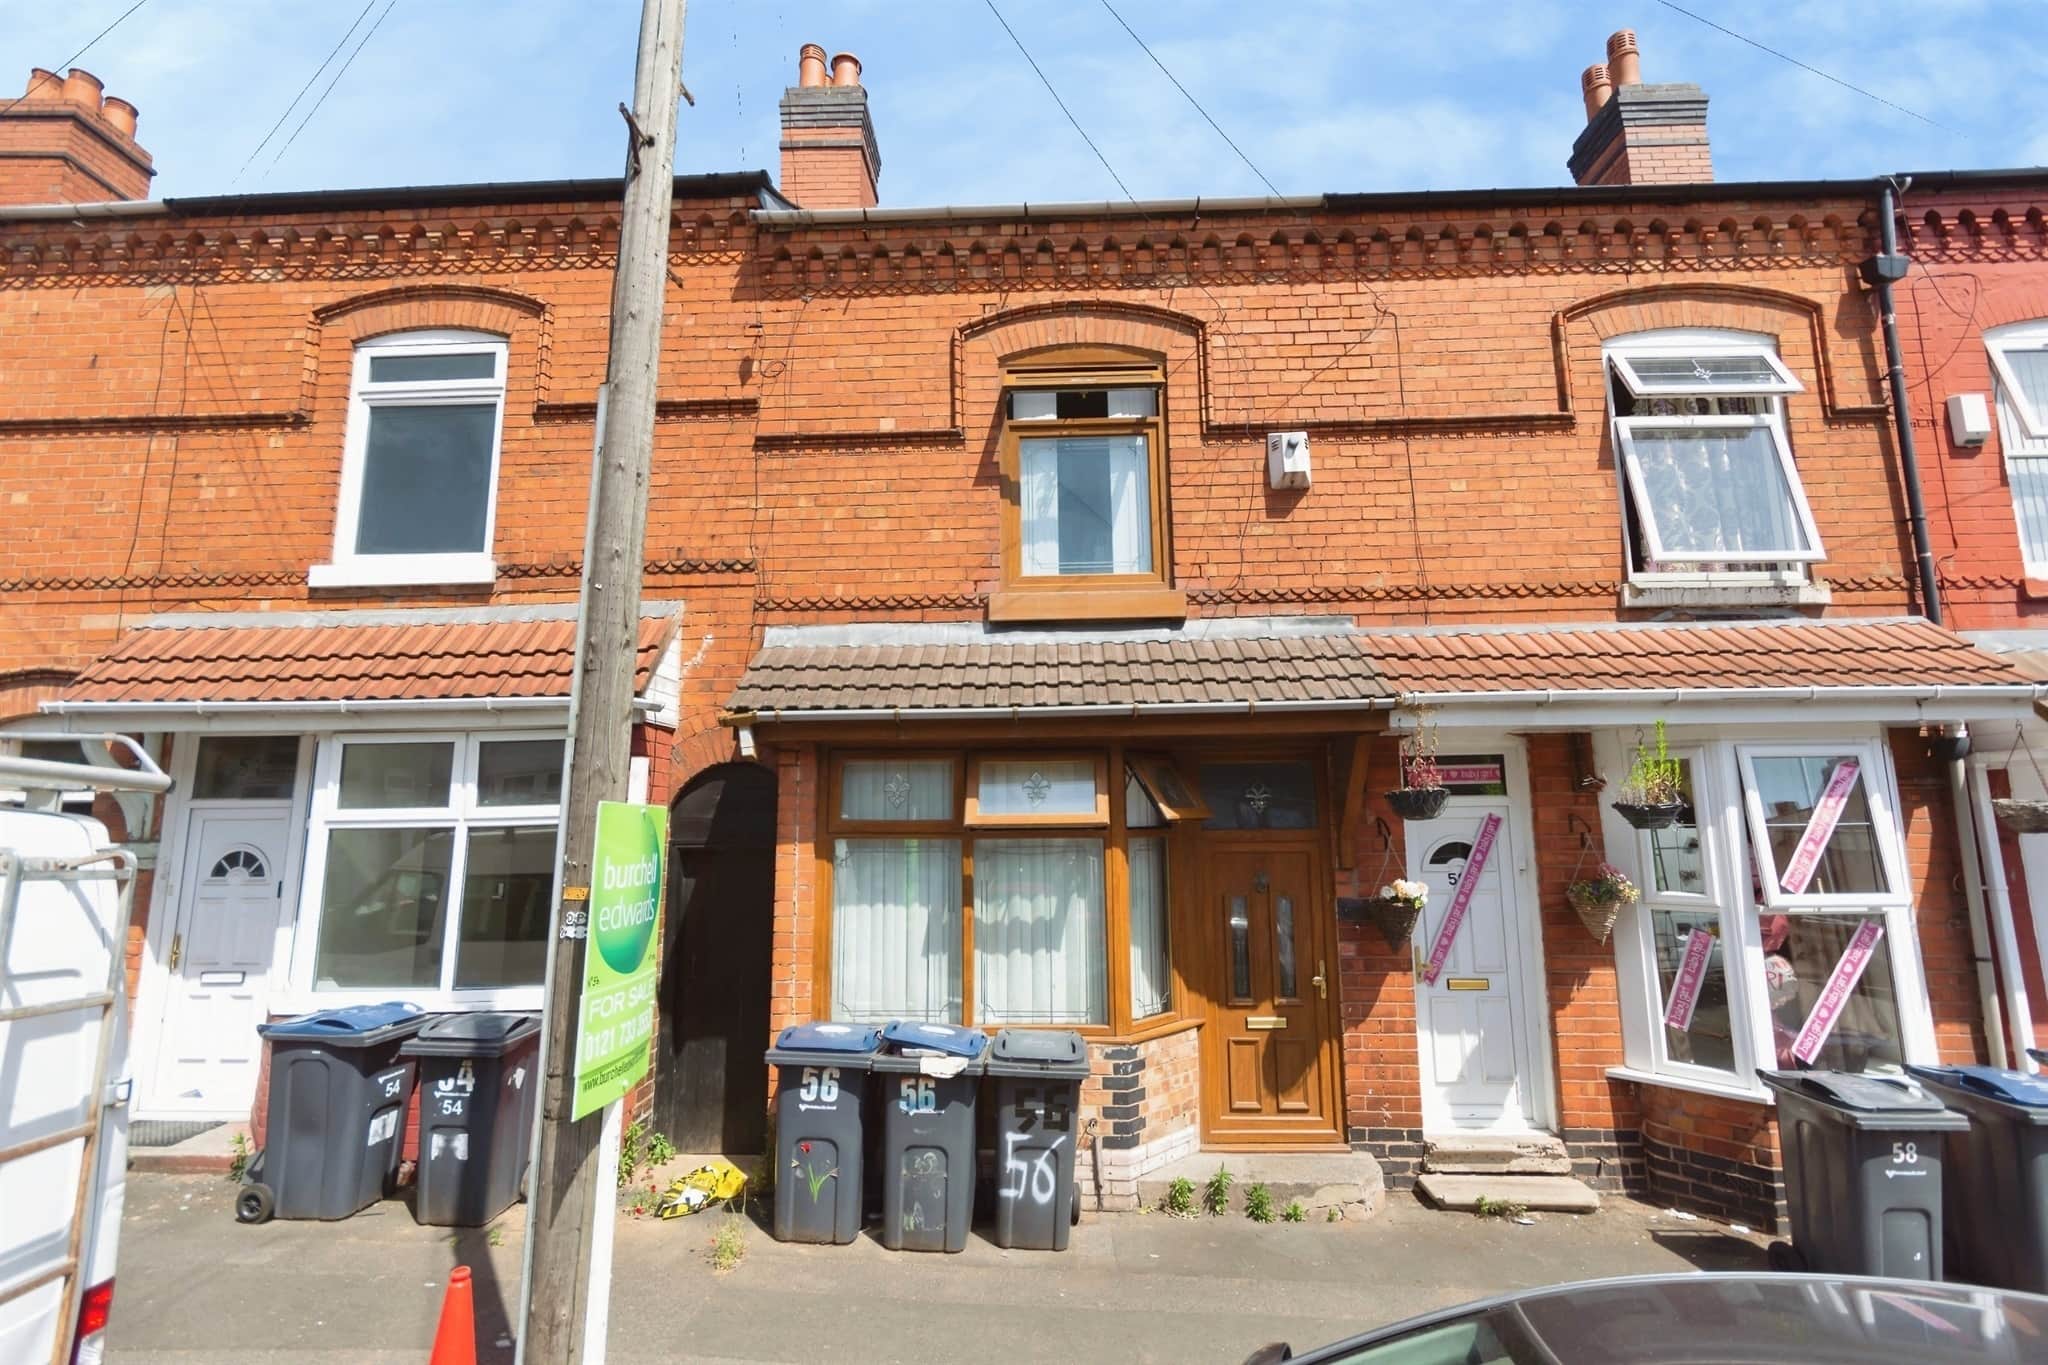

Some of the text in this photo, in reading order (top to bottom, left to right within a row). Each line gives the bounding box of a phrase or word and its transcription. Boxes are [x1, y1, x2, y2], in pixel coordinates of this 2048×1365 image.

[1486, 821, 1499, 835] girl
[1479, 833, 1495, 852] baby
[603, 852, 658, 890] burchell
[1447, 872, 1461, 886] 5
[1469, 862, 1482, 876] girl
[1463, 875, 1477, 894] baby
[599, 889, 656, 931] edwards
[1452, 904, 1465, 918] girl
[1445, 916, 1461, 937] baby
[1686, 951, 1704, 973] baby
[588, 991, 625, 1024] FOR
[628, 973, 656, 1008] SALE
[1678, 985, 1693, 1001] girl
[1799, 1031, 1819, 1055] baby
[1809, 1018, 1826, 1034] girl
[1824, 986, 1844, 1009] baby
[1834, 973, 1851, 990] girl
[1849, 941, 1869, 964] baby
[1671, 1000, 1690, 1021] baby
[584, 1026, 615, 1062] 0121
[385, 1080, 401, 1097] 54
[800, 1067, 840, 1102] 56
[900, 1077, 935, 1112] 56
[442, 1100, 463, 1115] 54
[1892, 1142, 1918, 1164] 58
[999, 1131, 1067, 1204] 56
